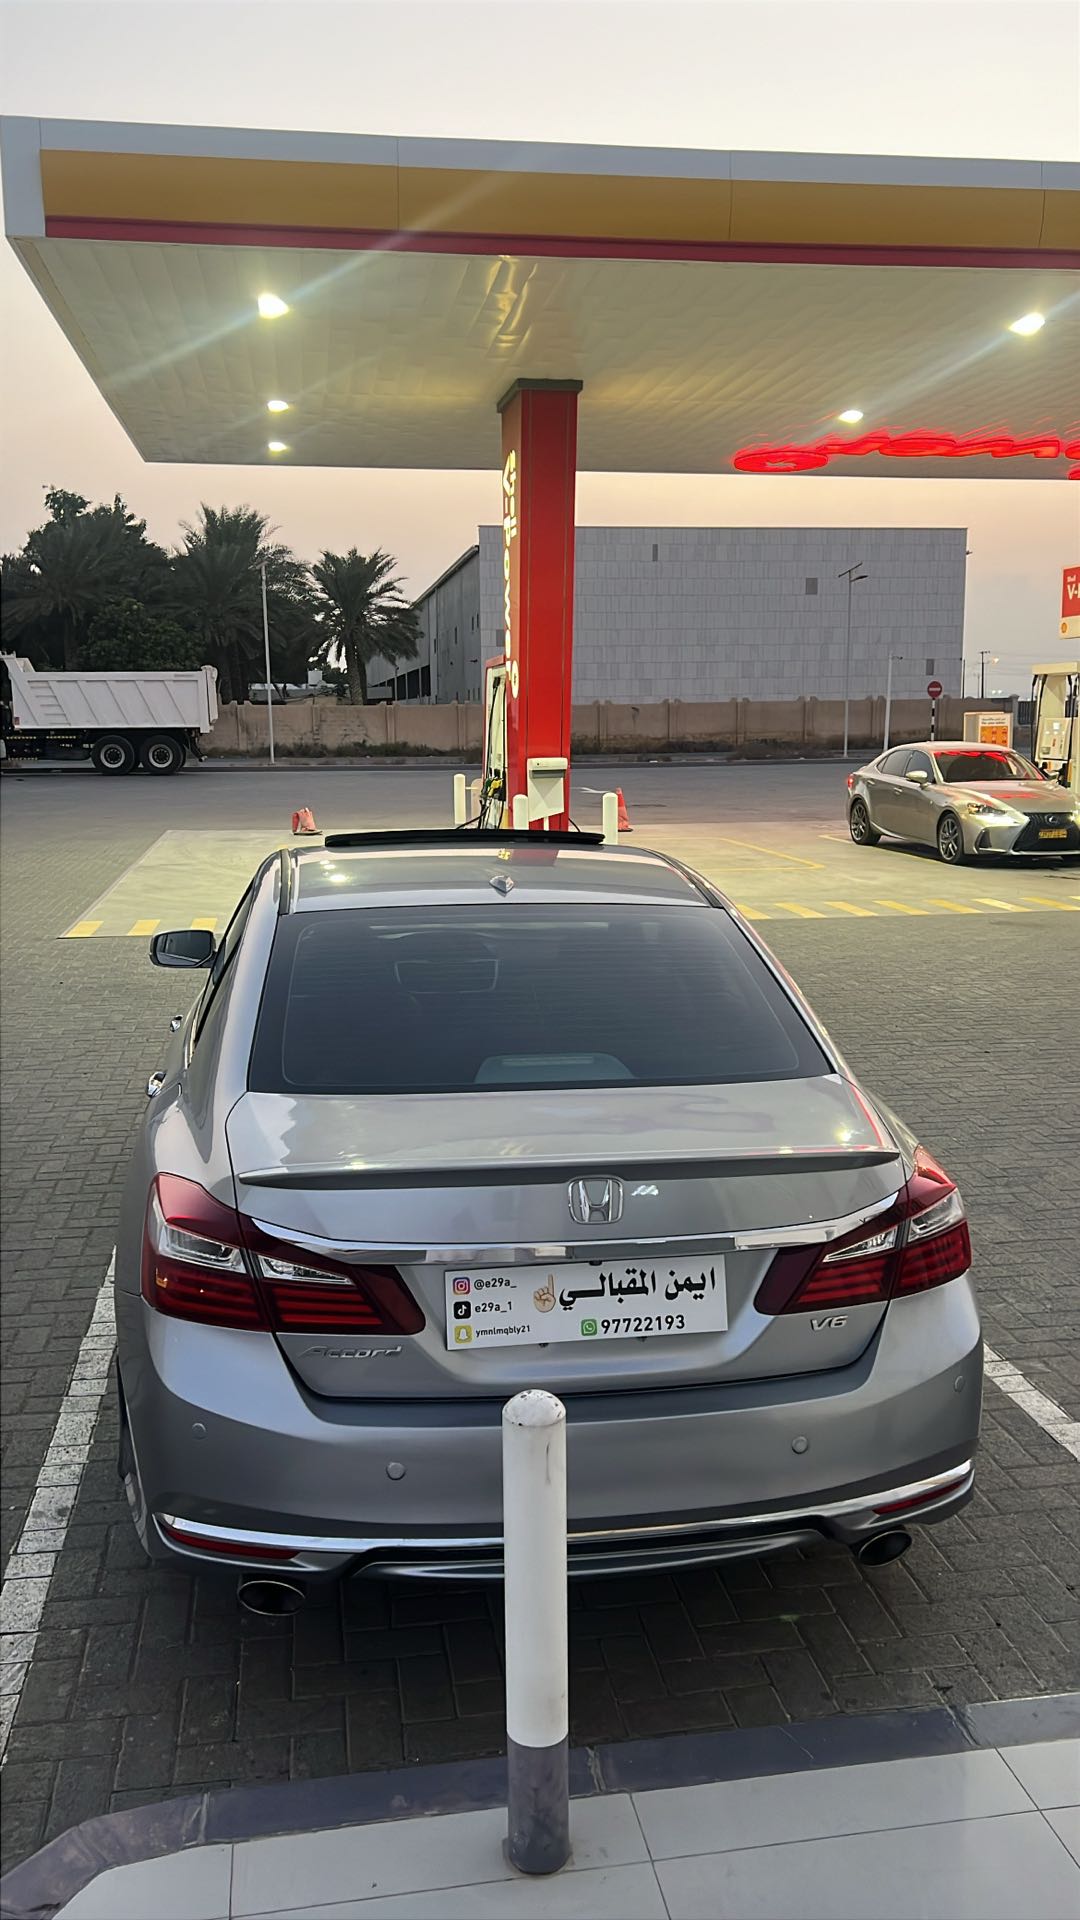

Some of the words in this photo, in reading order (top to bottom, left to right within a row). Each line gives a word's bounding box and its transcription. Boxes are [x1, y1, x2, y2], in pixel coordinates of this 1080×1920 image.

[474, 1277, 517, 1290] @e29a_
[665, 1267, 716, 1301] ايمن
[475, 1301, 512, 1313] e29a_1
[601, 1315, 685, 1334] 97722193
[810, 1315, 848, 1330] V6
[475, 1325, 531, 1338] ymnlmqbly21
